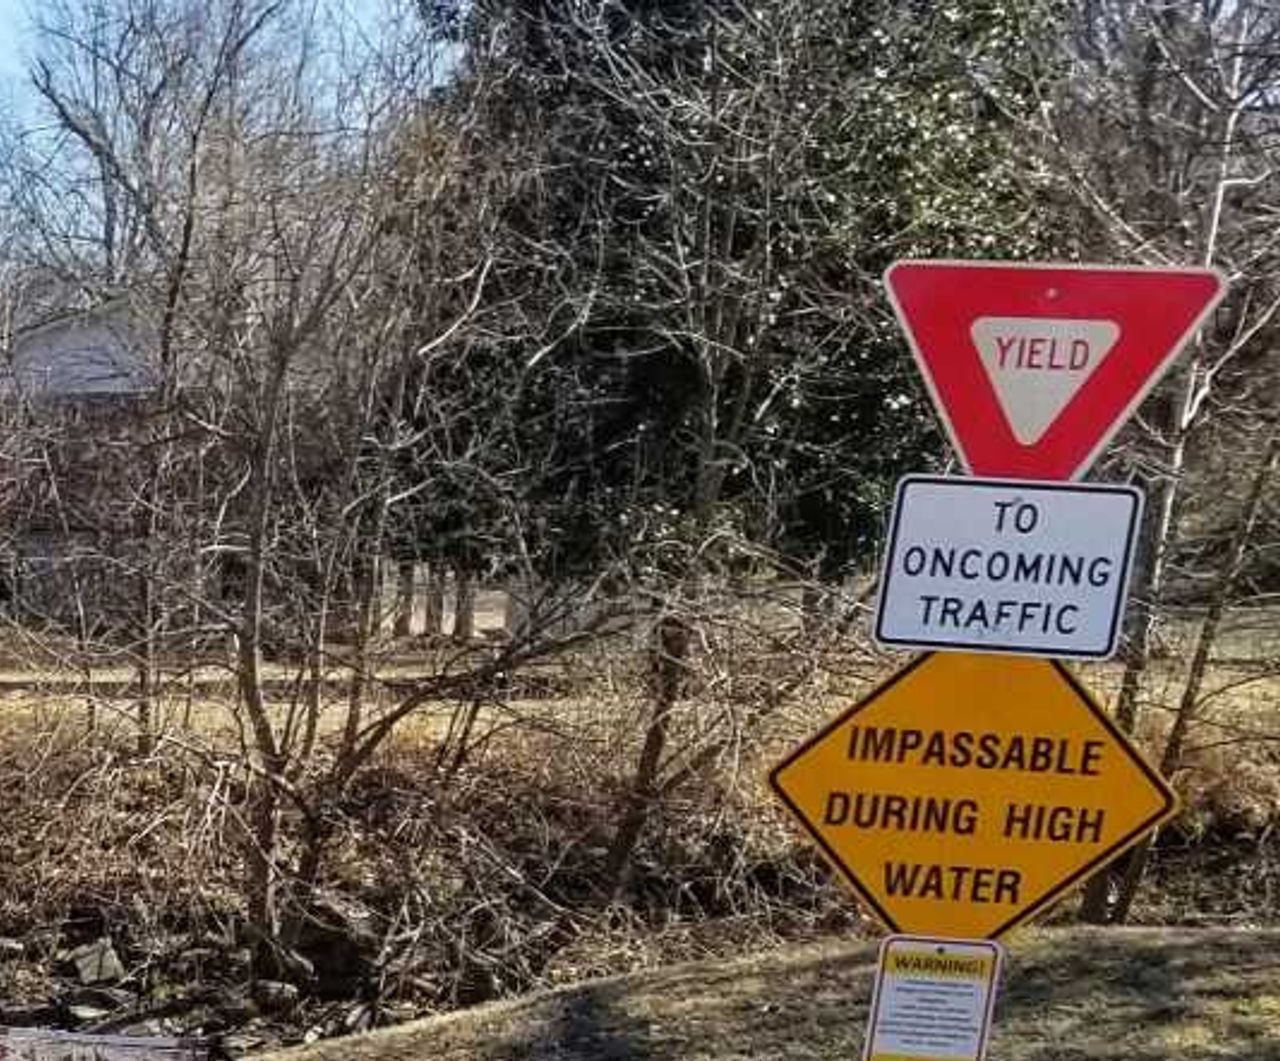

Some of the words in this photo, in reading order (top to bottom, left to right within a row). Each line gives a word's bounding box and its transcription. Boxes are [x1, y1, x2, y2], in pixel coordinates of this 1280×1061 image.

[994, 336, 1090, 371] YIELD
[993, 500, 1039, 534] TO
[902, 546, 1113, 587] ONCOMING
[919, 595, 1079, 634] TRAFFIC
[847, 726, 1106, 776] IMPASSABLE
[824, 791, 979, 835] DURING
[1003, 803, 1106, 843] HIGH
[882, 860, 1023, 905] WATER
[895, 956, 985, 975] WARNING!
